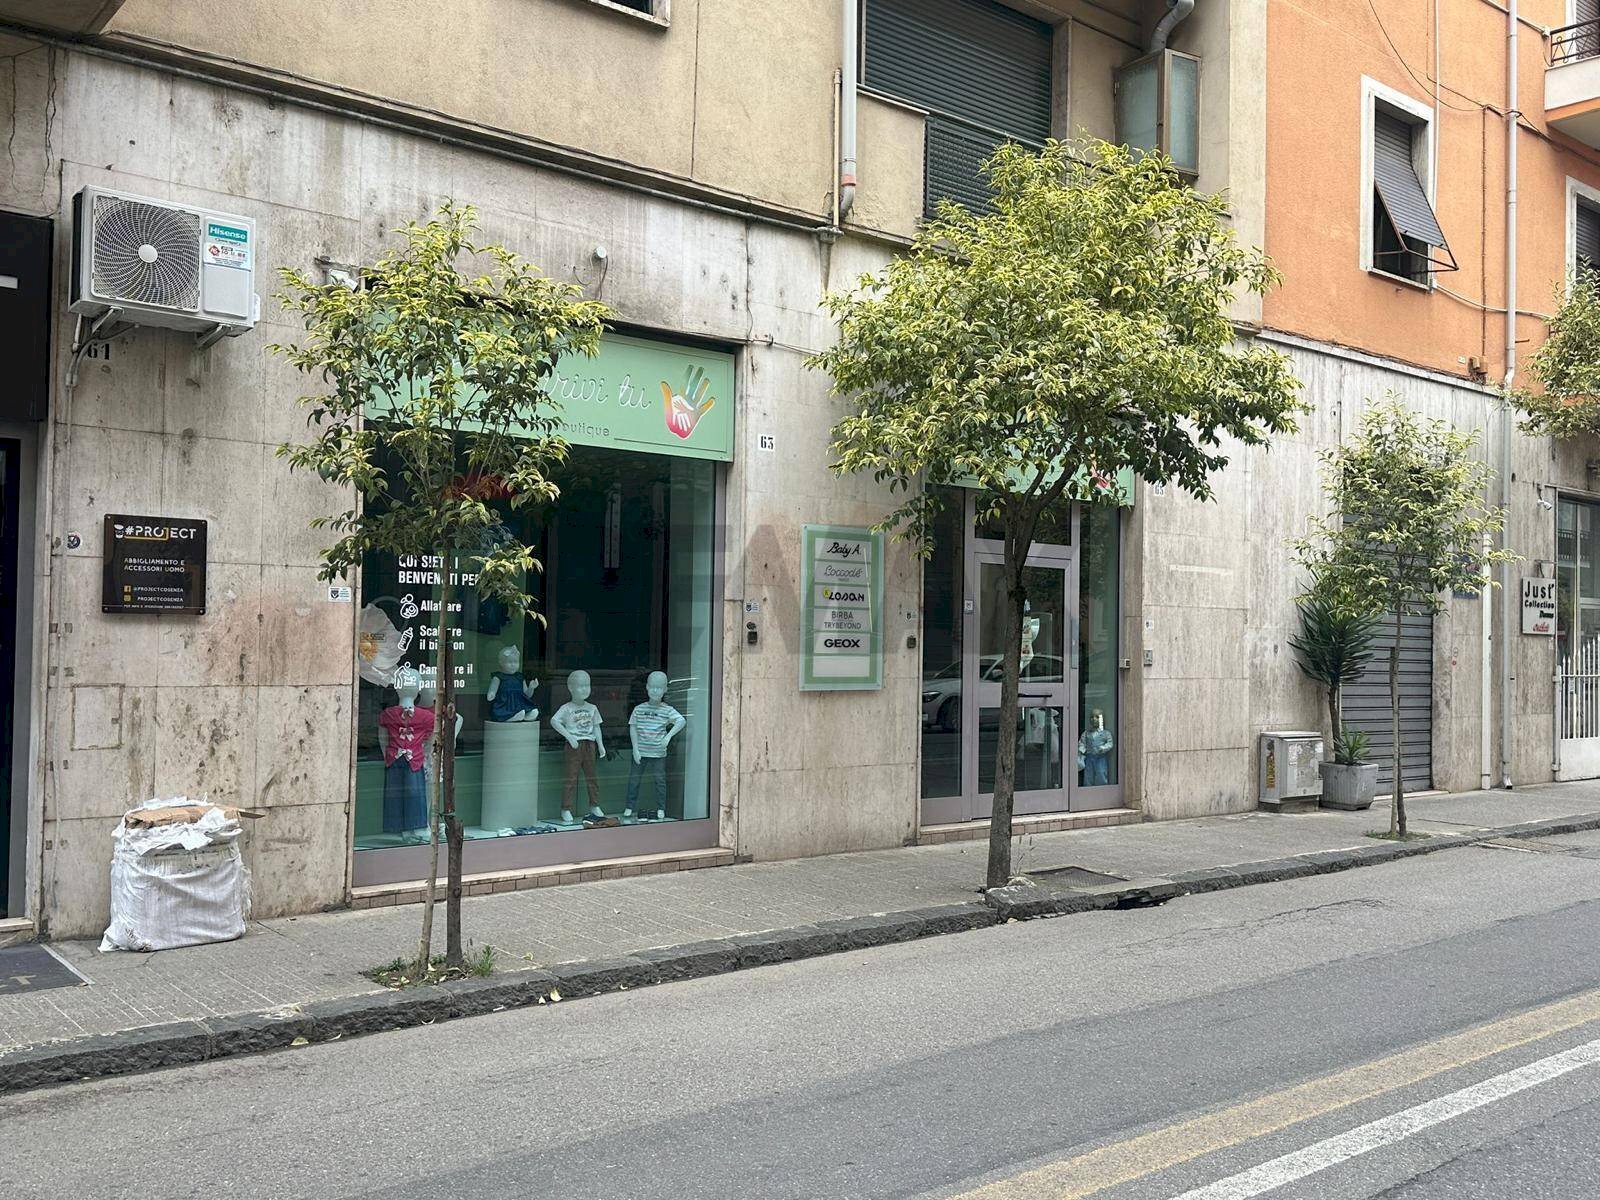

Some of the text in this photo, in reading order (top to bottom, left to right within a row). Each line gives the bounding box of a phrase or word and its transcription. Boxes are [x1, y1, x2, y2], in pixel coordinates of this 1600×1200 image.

[209, 226, 246, 240] Hisense
[87, 341, 110, 361] 61
[557, 421, 610, 438] outique
[760, 435, 774, 450] 63
[827, 541, 851, 558] Baby
[124, 558, 178, 566] ABBIGLIAMENTO
[421, 555, 452, 569] SIET
[398, 570, 458, 586] BENVENTI
[420, 600, 462, 612] Allatare
[1525, 600, 1554, 609] Collection
[832, 611, 854, 620] BIRBA
[419, 625, 462, 637] Scalre
[419, 640, 465, 651] il bion
[824, 639, 860, 648] GEOX
[418, 664, 473, 675] Camre il
